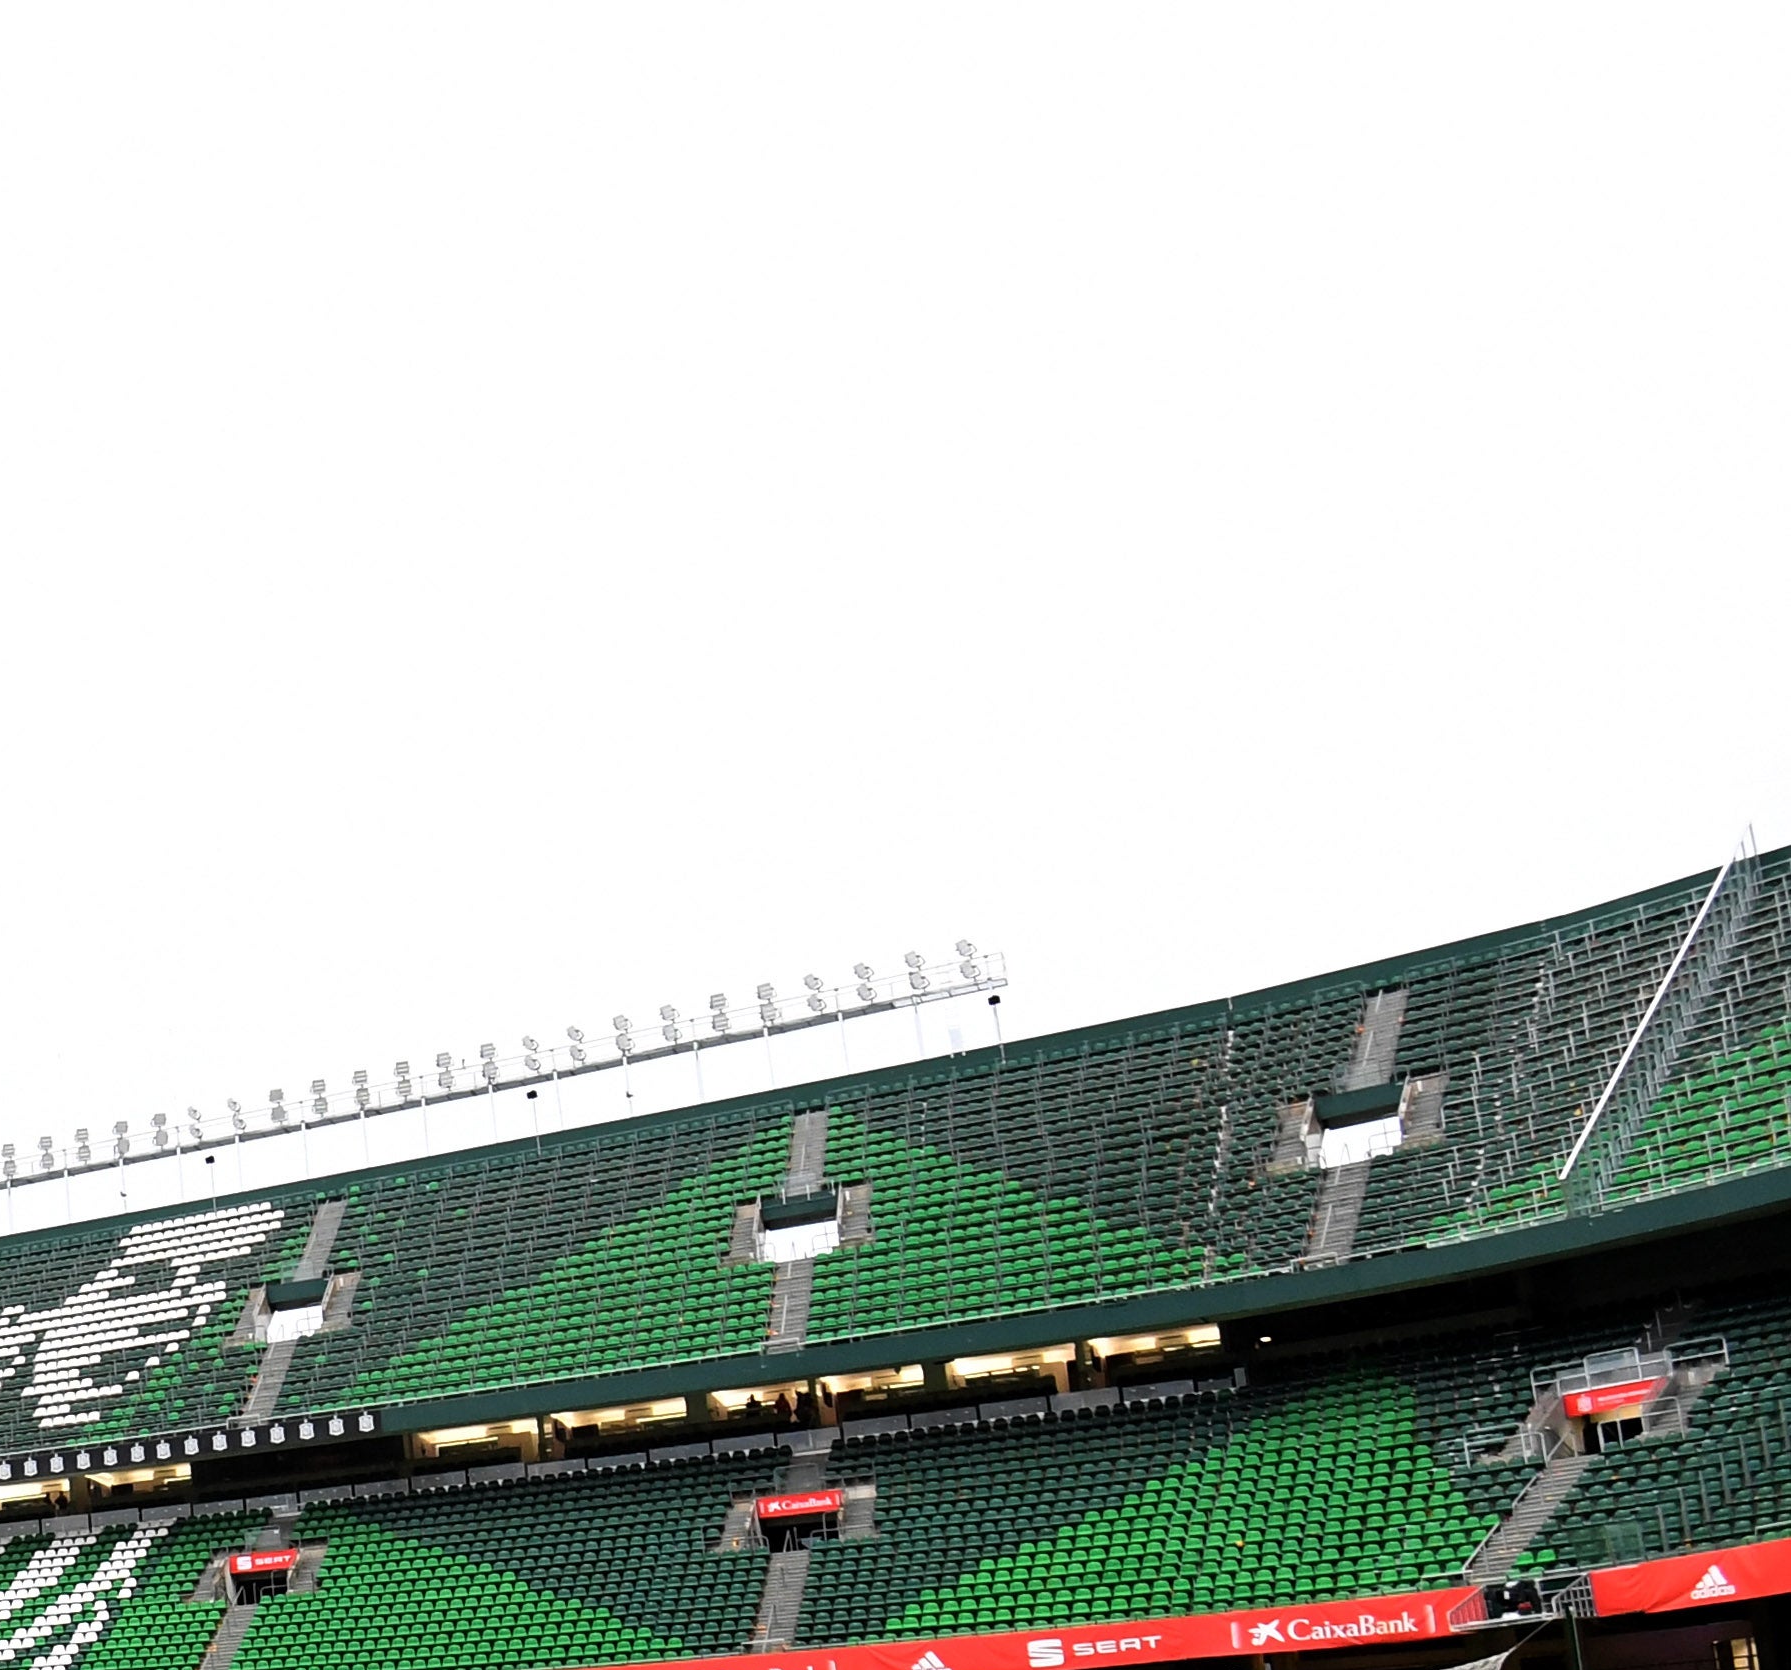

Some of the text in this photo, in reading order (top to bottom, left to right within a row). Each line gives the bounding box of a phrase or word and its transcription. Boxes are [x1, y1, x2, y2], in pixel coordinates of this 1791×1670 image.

[1689, 1584, 1737, 1601] adidas
[1286, 1611, 1419, 1641] CaixaBank
[1072, 1635, 1162, 1657] SEAT
